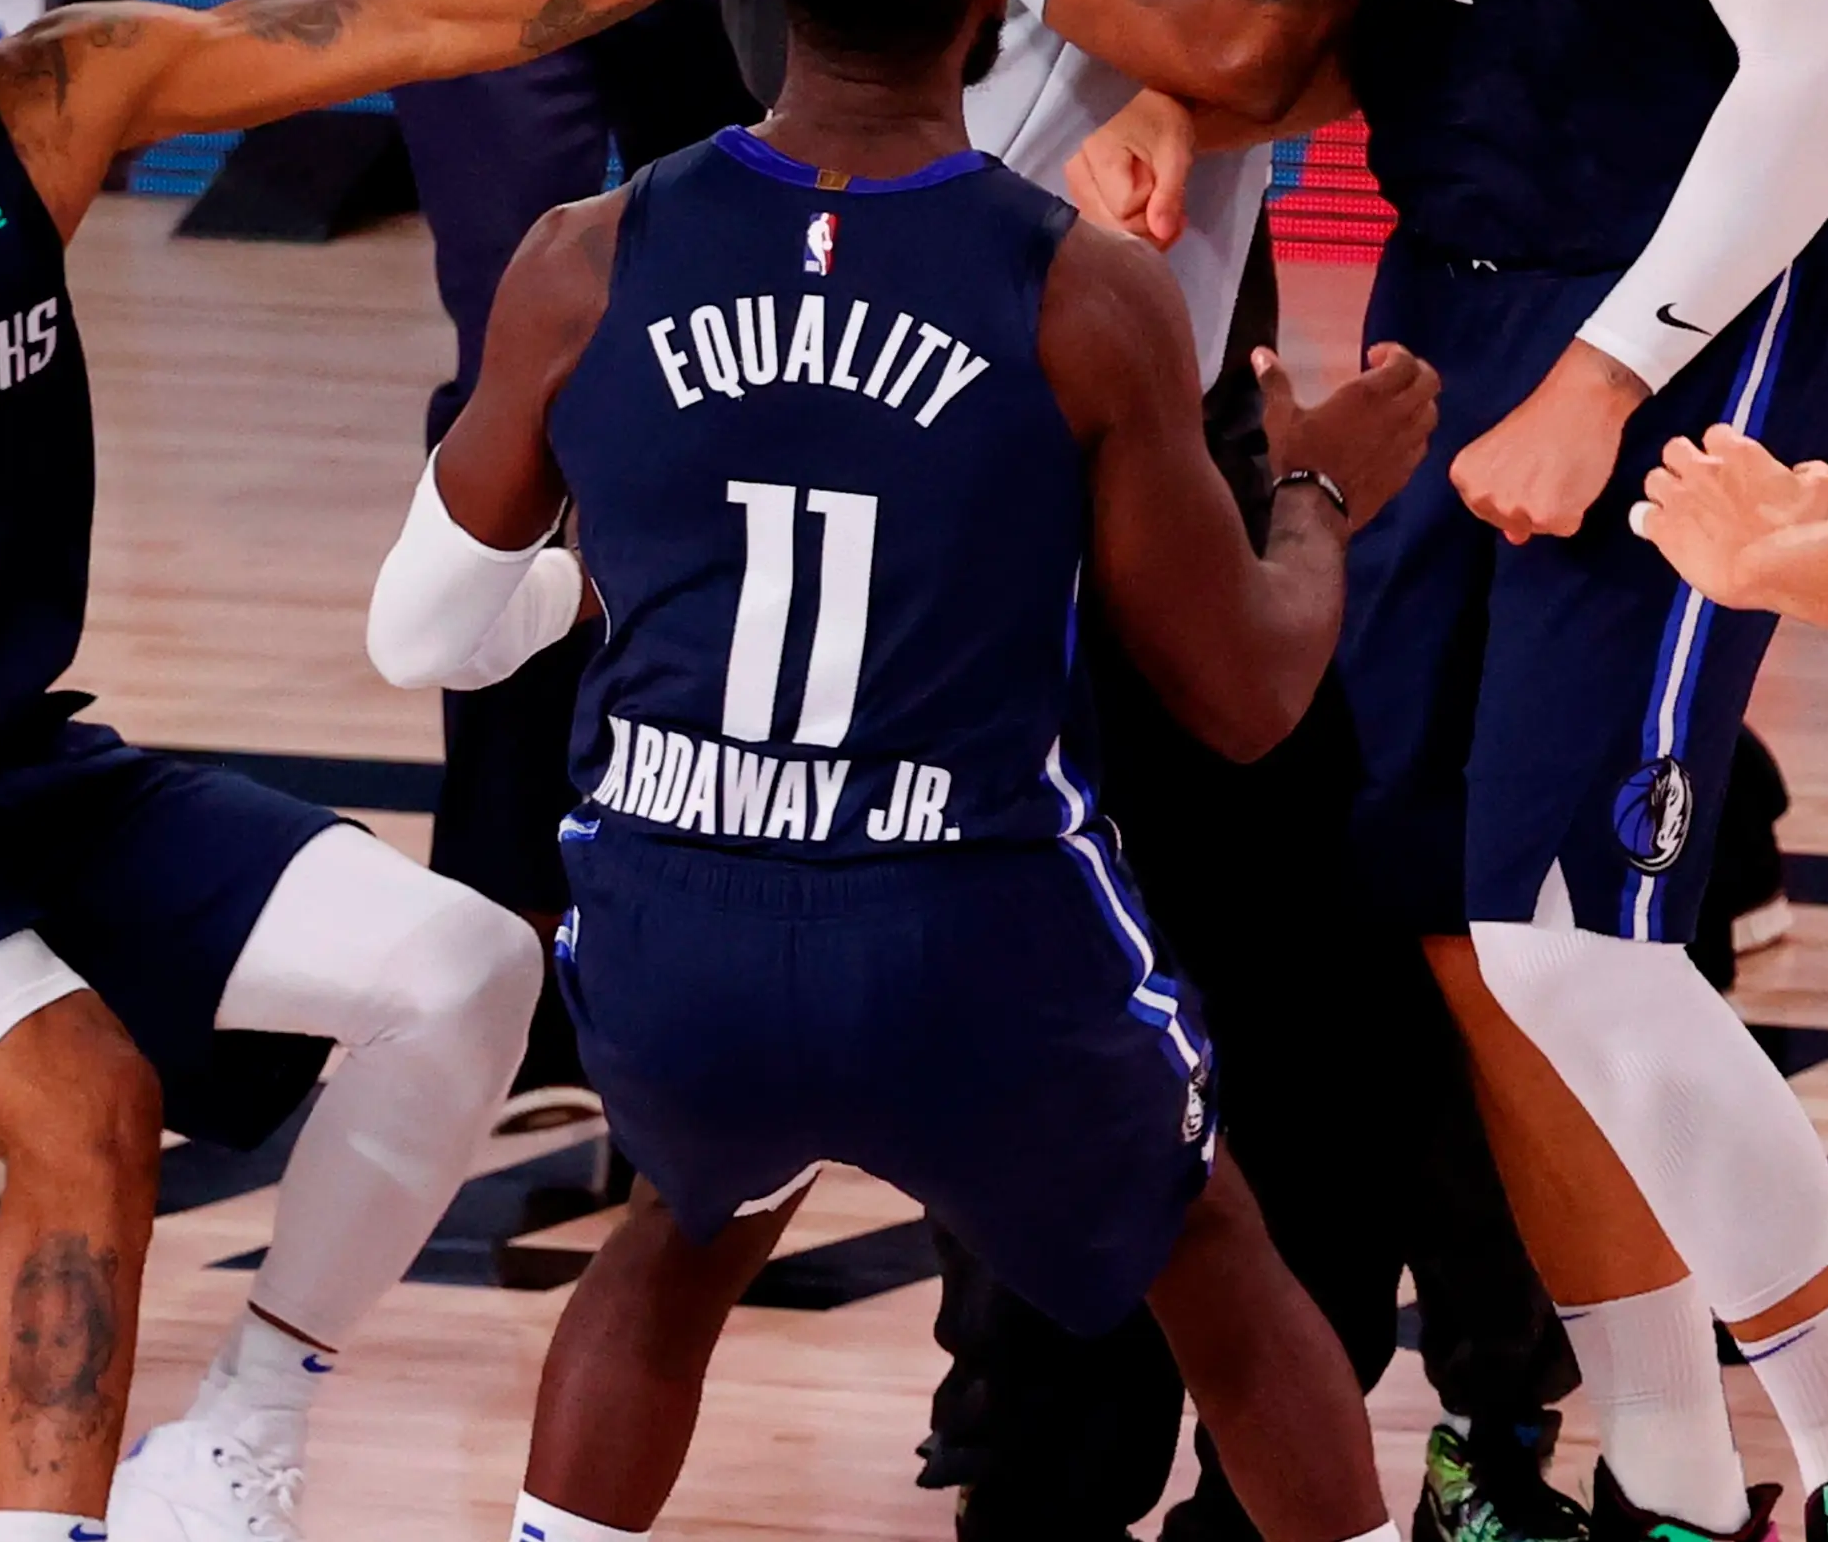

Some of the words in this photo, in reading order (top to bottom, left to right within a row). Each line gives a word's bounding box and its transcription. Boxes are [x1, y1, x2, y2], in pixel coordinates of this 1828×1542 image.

[647, 294, 990, 428] EQUALITY
[721, 479, 879, 749] 11
[866, 760, 961, 843] JR.
